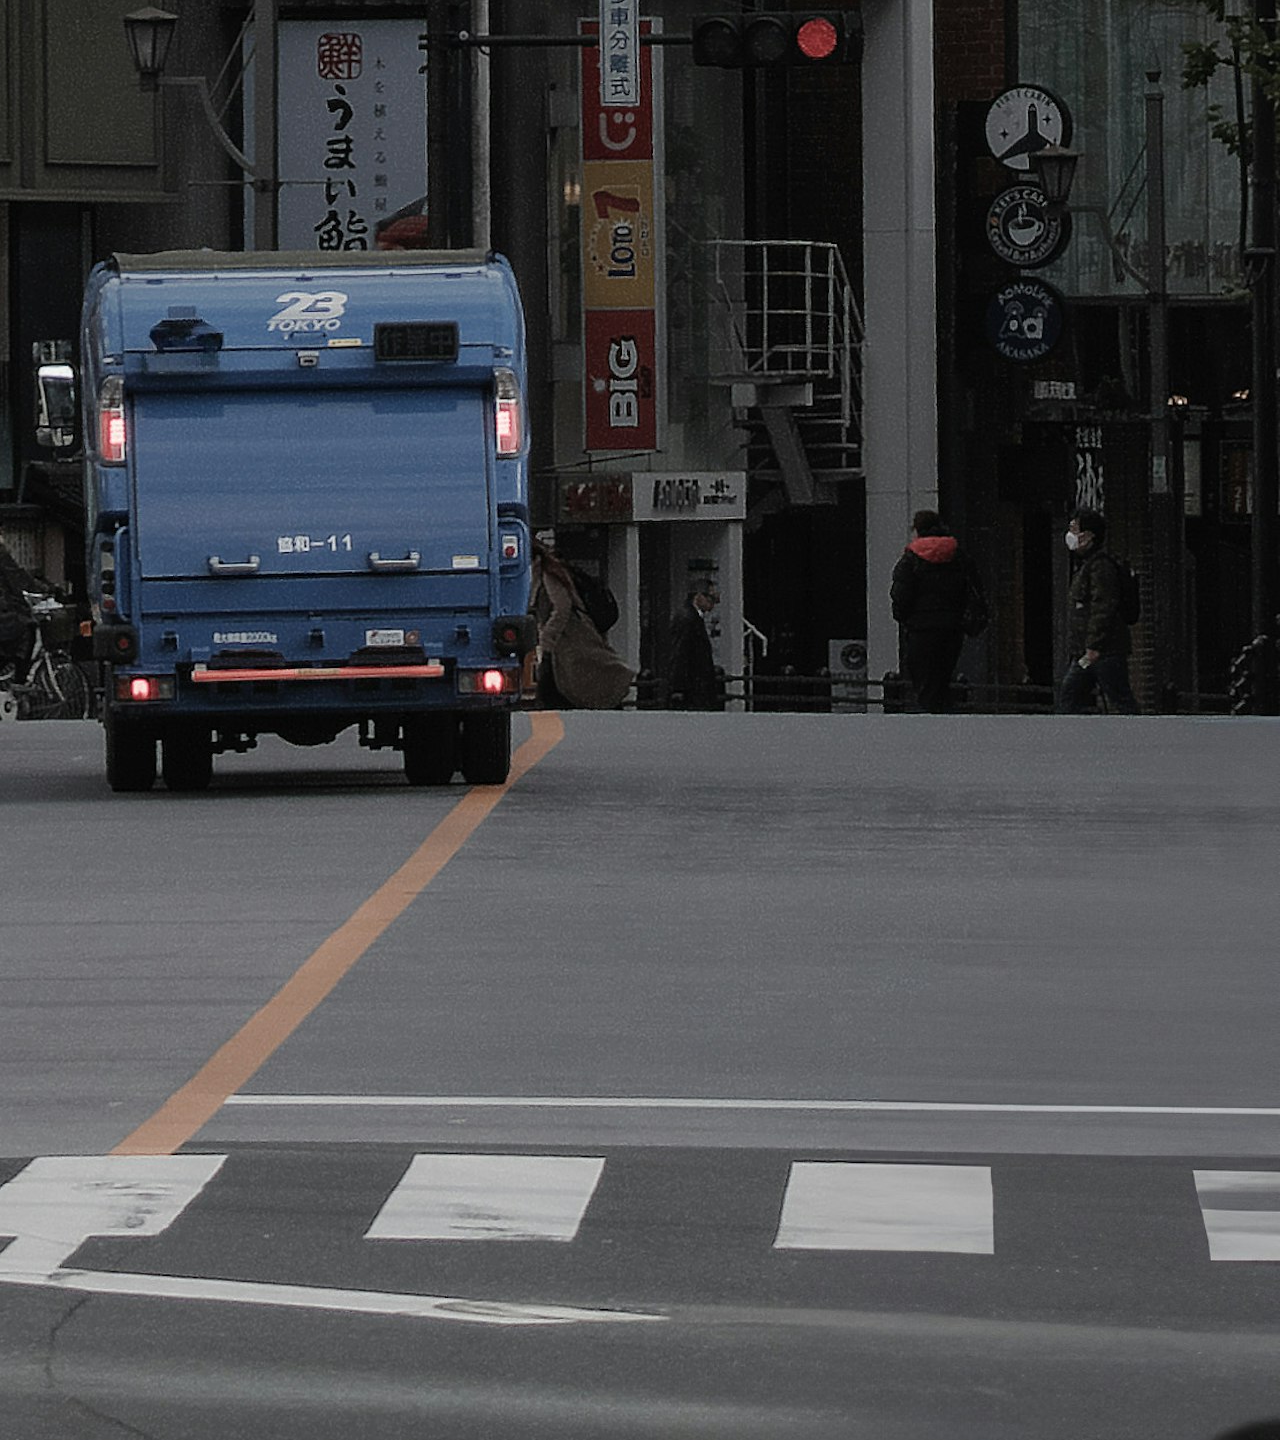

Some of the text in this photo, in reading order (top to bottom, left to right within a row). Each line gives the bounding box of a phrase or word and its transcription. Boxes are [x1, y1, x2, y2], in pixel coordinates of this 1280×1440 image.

[271, 291, 349, 320] 23
[266, 318, 341, 332] TOKYO
[609, 337, 639, 427] BIG
